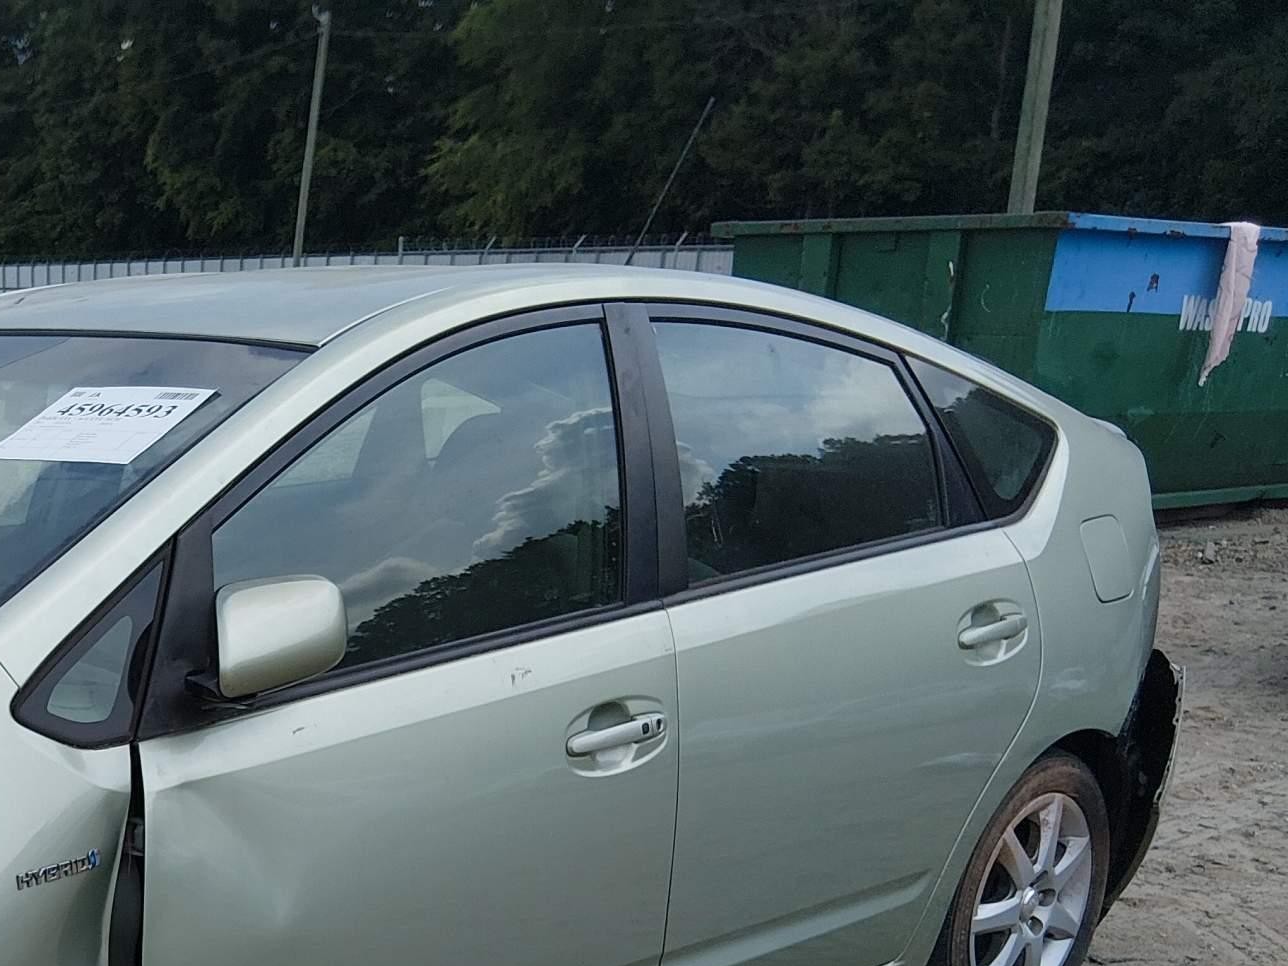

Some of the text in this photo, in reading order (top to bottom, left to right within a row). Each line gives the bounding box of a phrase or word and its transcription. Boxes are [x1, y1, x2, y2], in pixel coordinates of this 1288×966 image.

[1179, 295, 1273, 333] WAS PRO
[57, 403, 178, 418] 45964593
[16, 855, 89, 890] HYBRID
